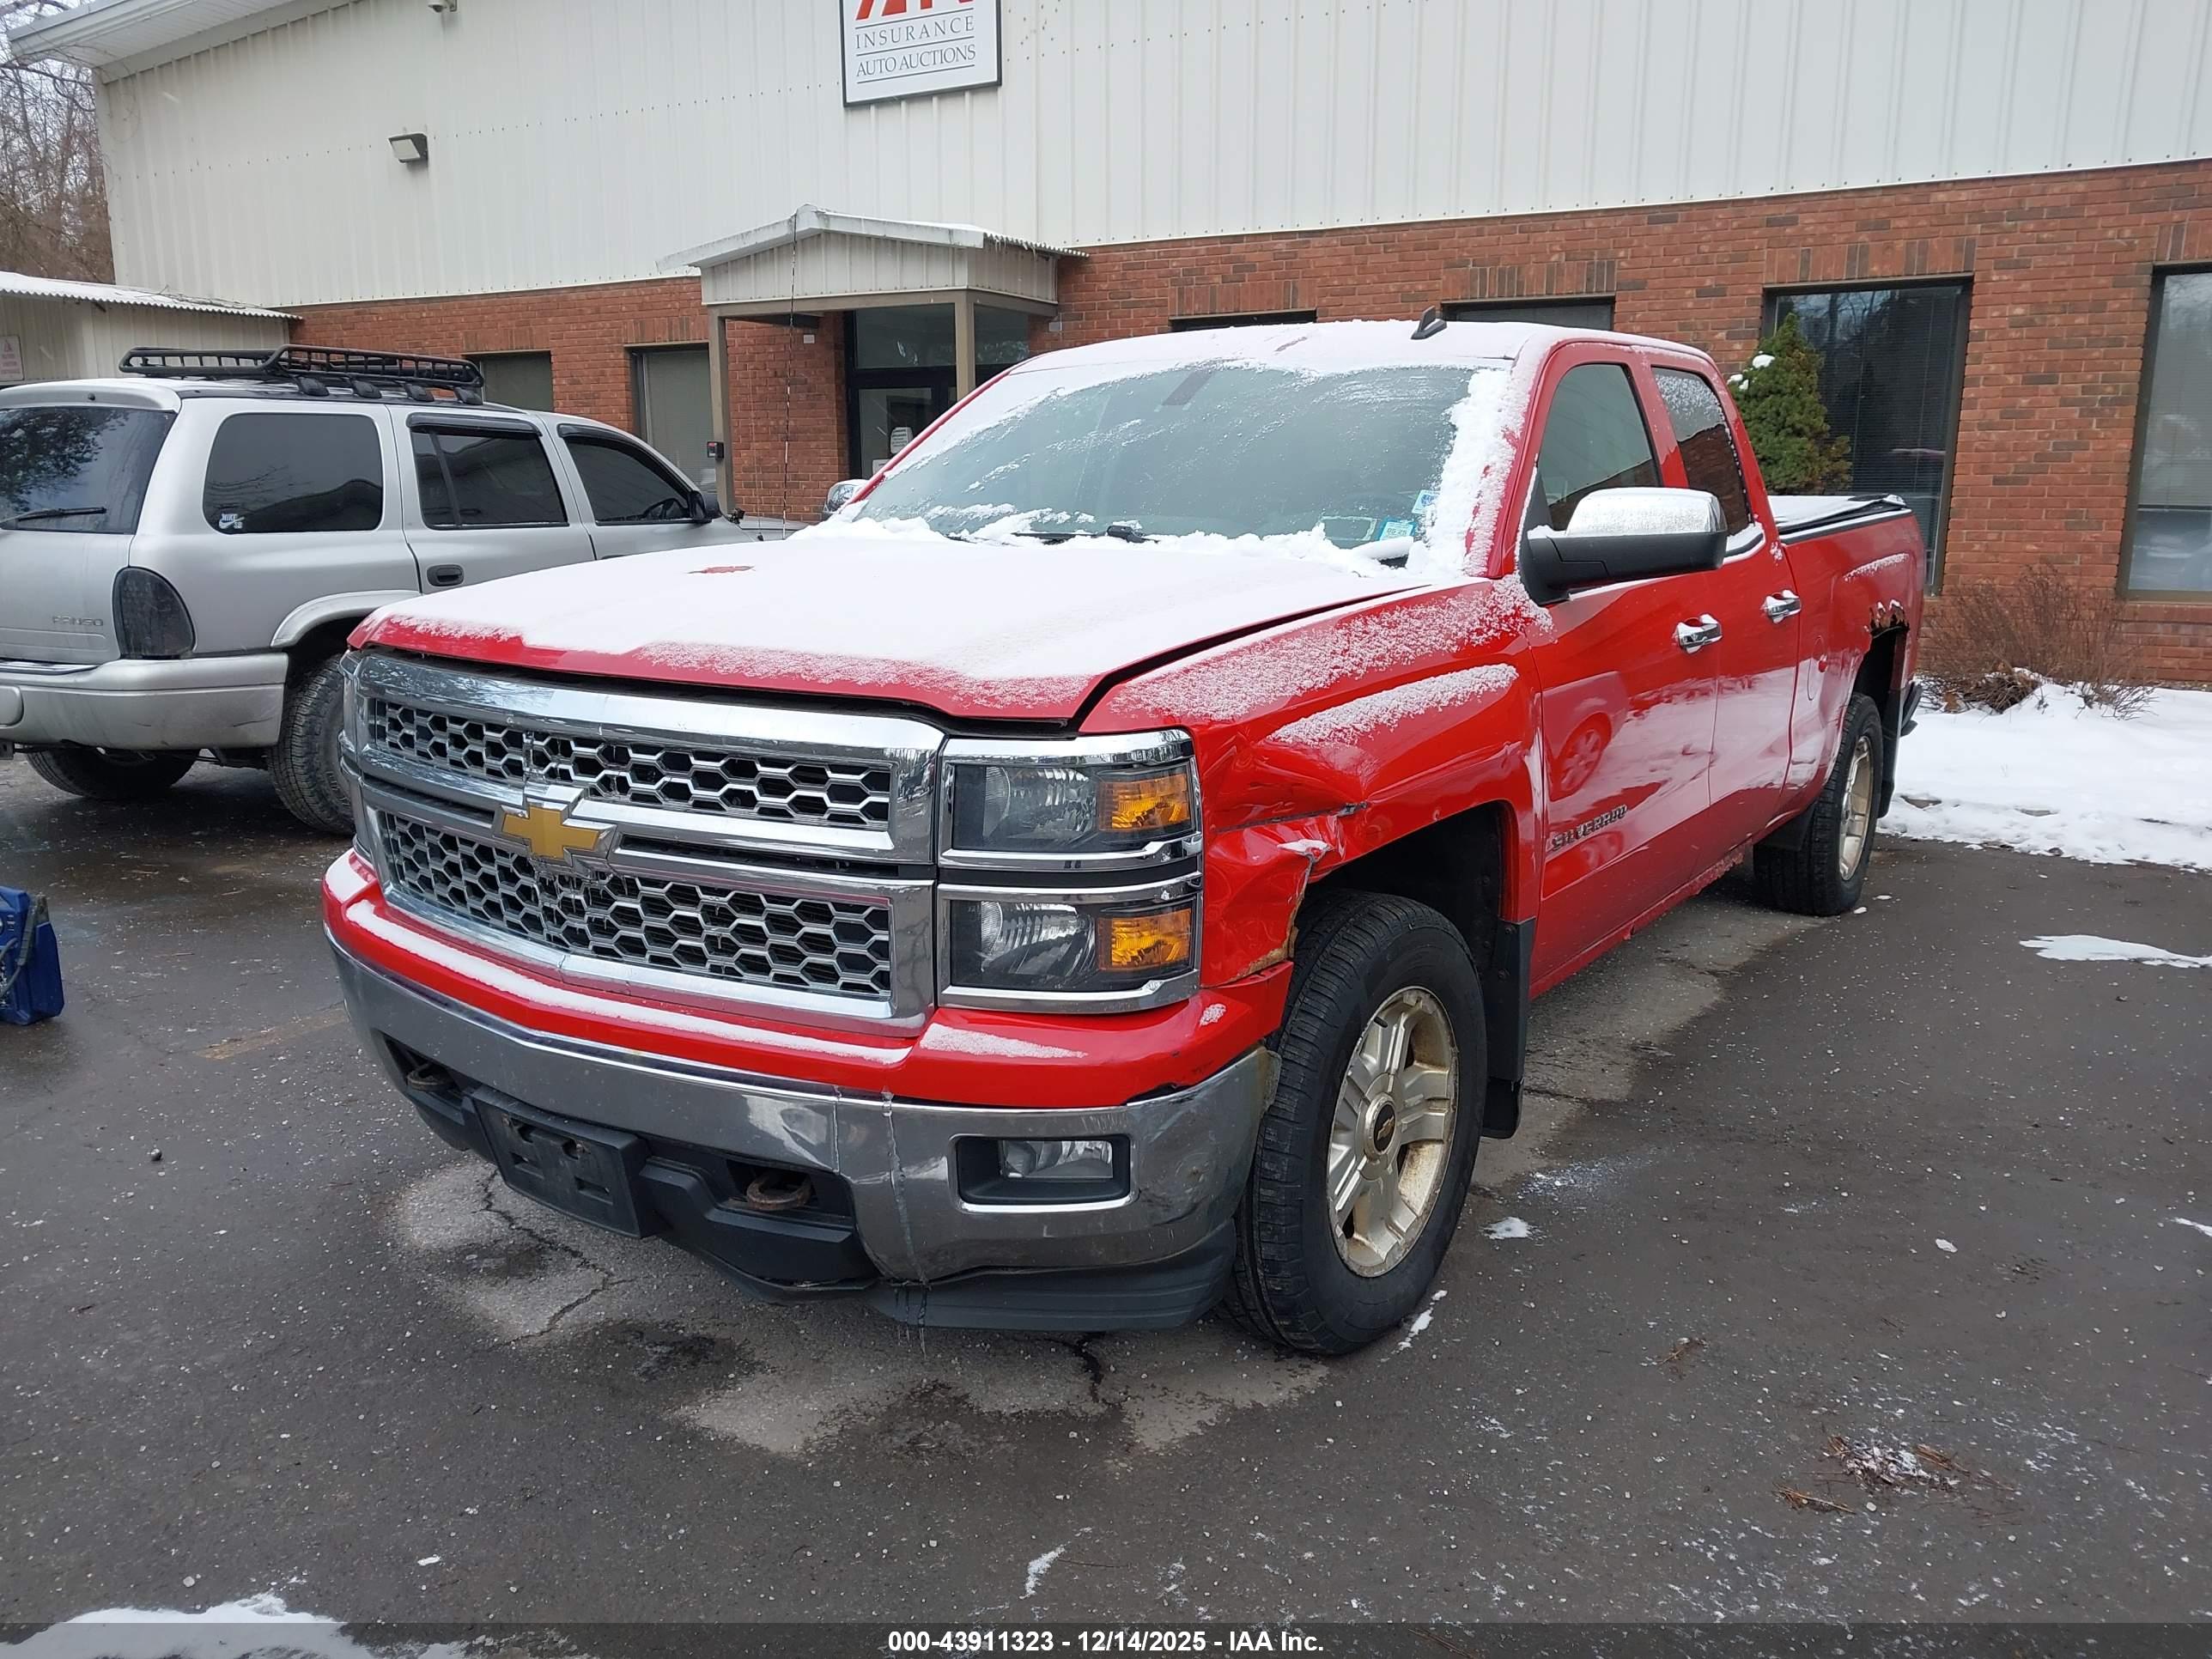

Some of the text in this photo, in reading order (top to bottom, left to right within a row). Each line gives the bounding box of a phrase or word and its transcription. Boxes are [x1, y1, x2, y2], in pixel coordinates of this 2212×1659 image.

[855, 15, 975, 49] INSURANCE
[856, 44, 975, 77] AUTO AUCTIONS
